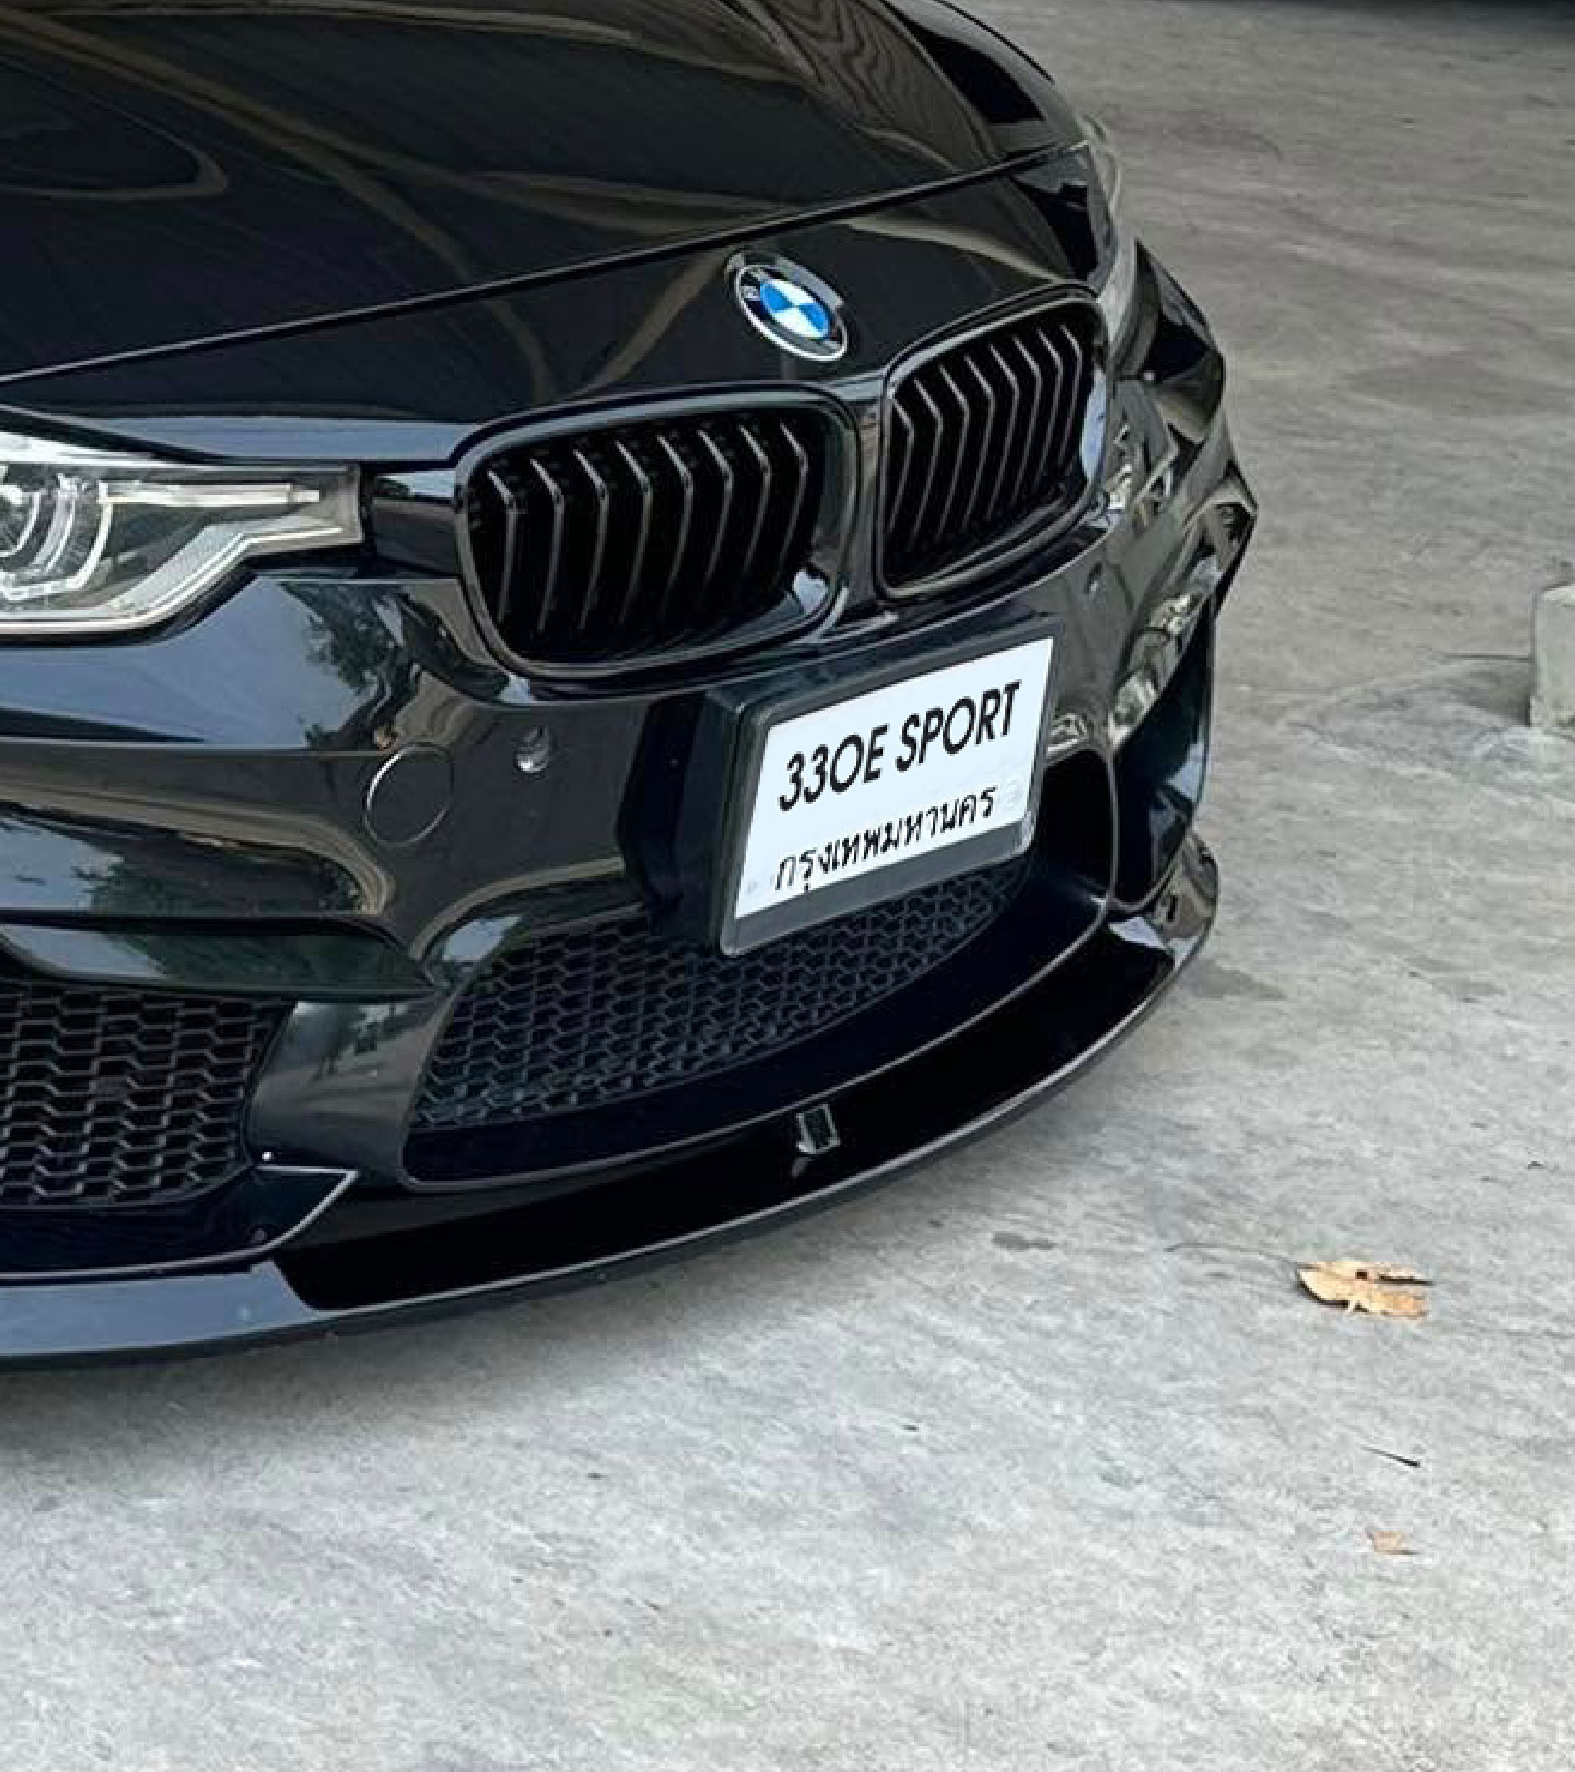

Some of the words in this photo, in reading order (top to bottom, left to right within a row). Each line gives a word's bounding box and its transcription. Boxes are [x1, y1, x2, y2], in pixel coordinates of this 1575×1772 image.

[895, 680, 1022, 772] SPORT
[775, 786, 998, 891] กรุงเทพมหานคร
